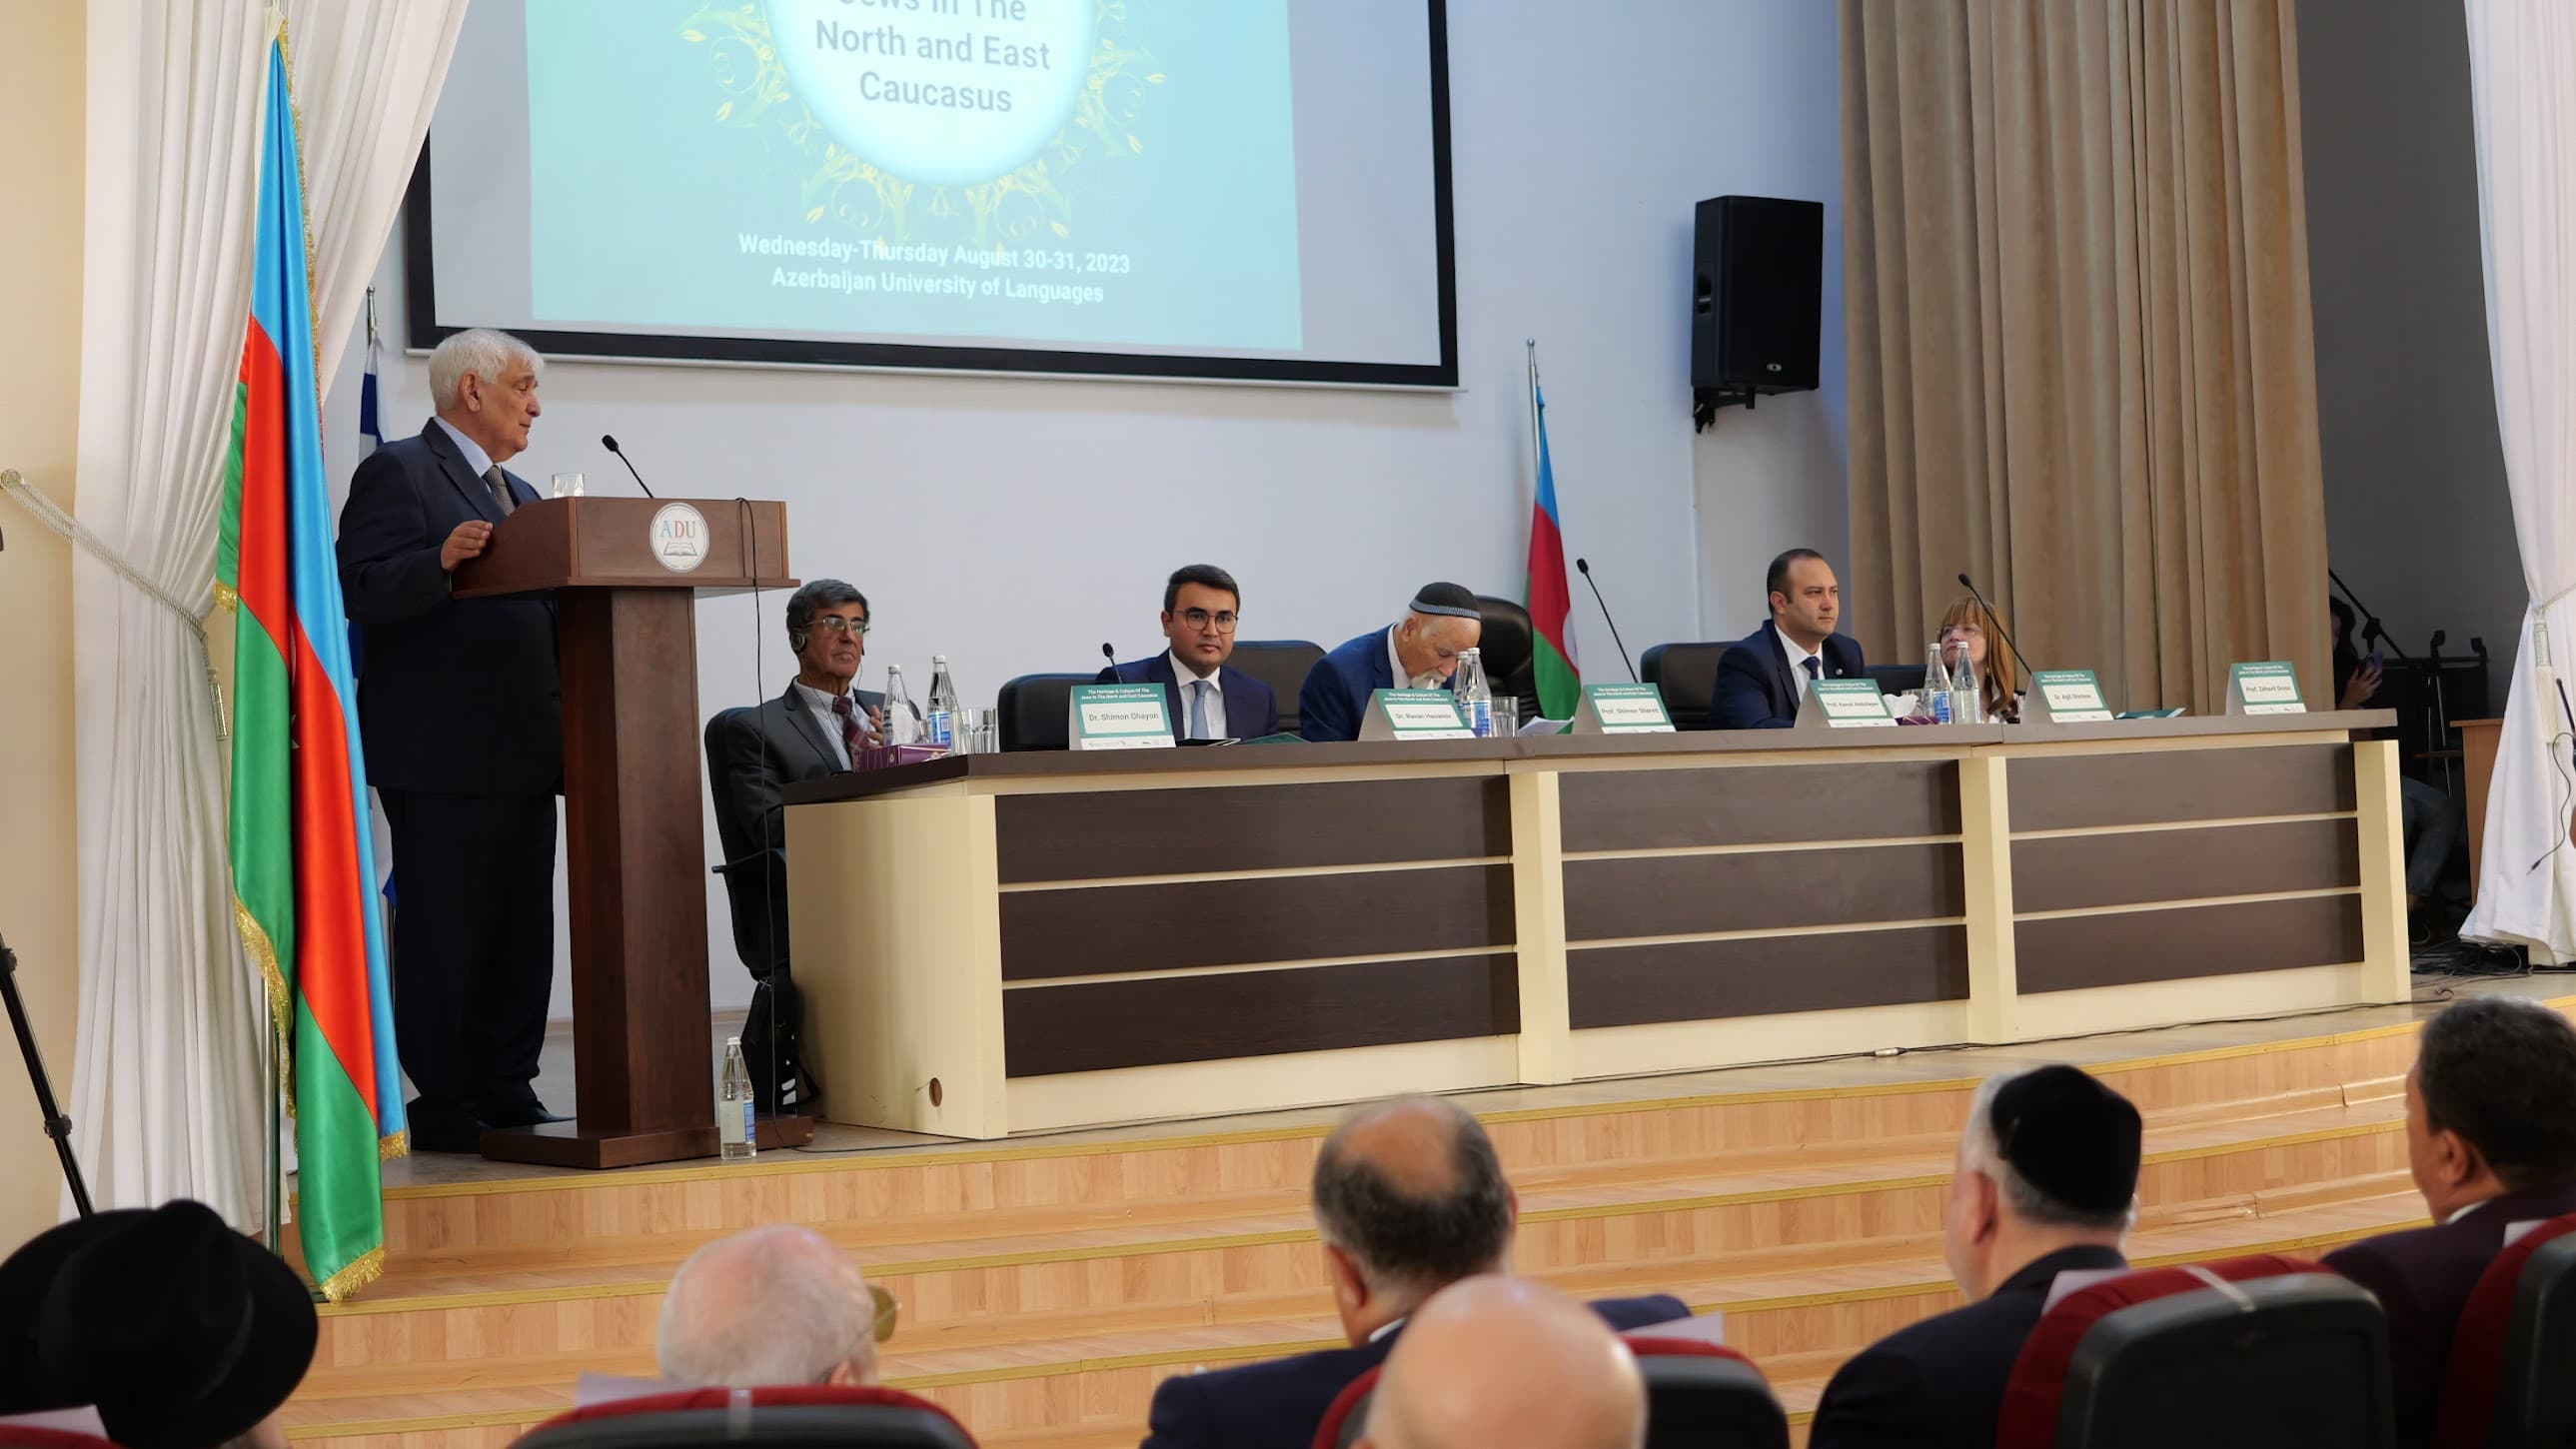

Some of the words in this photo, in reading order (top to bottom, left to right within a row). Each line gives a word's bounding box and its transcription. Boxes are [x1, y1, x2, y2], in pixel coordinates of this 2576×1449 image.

[815, 19, 906, 57] North
[916, 32, 973, 63] and
[983, 35, 1051, 70] East
[859, 71, 1012, 113] Caucasus
[738, 232, 949, 267] Wednesday-Thursday
[953, 244, 1019, 270] August
[1023, 248, 1082, 274] 30-31,
[1086, 252, 1130, 274] 2023
[771, 266, 876, 295] Azerbaijan
[881, 271, 977, 299] University
[981, 276, 1000, 296] of
[1005, 279, 1104, 305] Languages
[660, 520, 696, 539] ADU
